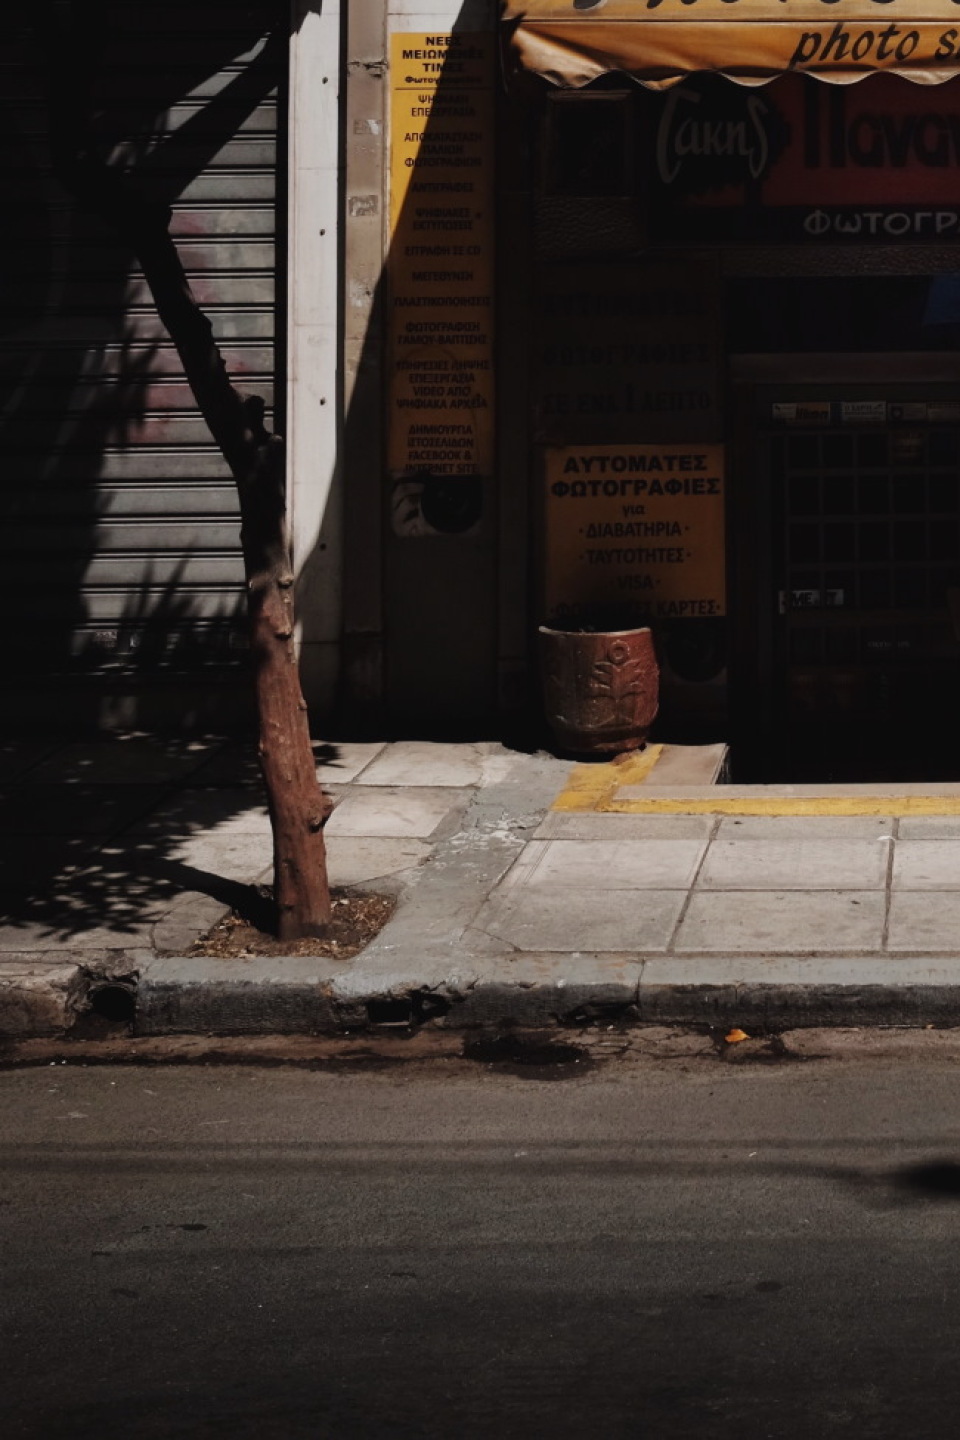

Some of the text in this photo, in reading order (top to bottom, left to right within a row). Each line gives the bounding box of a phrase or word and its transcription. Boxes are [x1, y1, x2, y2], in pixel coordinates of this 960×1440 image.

[790, 22, 919, 68] photo
[563, 455, 707, 473] ΑΥΤΟΜΑΤΕΣ
[551, 478, 720, 497] ΦΩΤΟΓΡΑΦΙΕΣ
